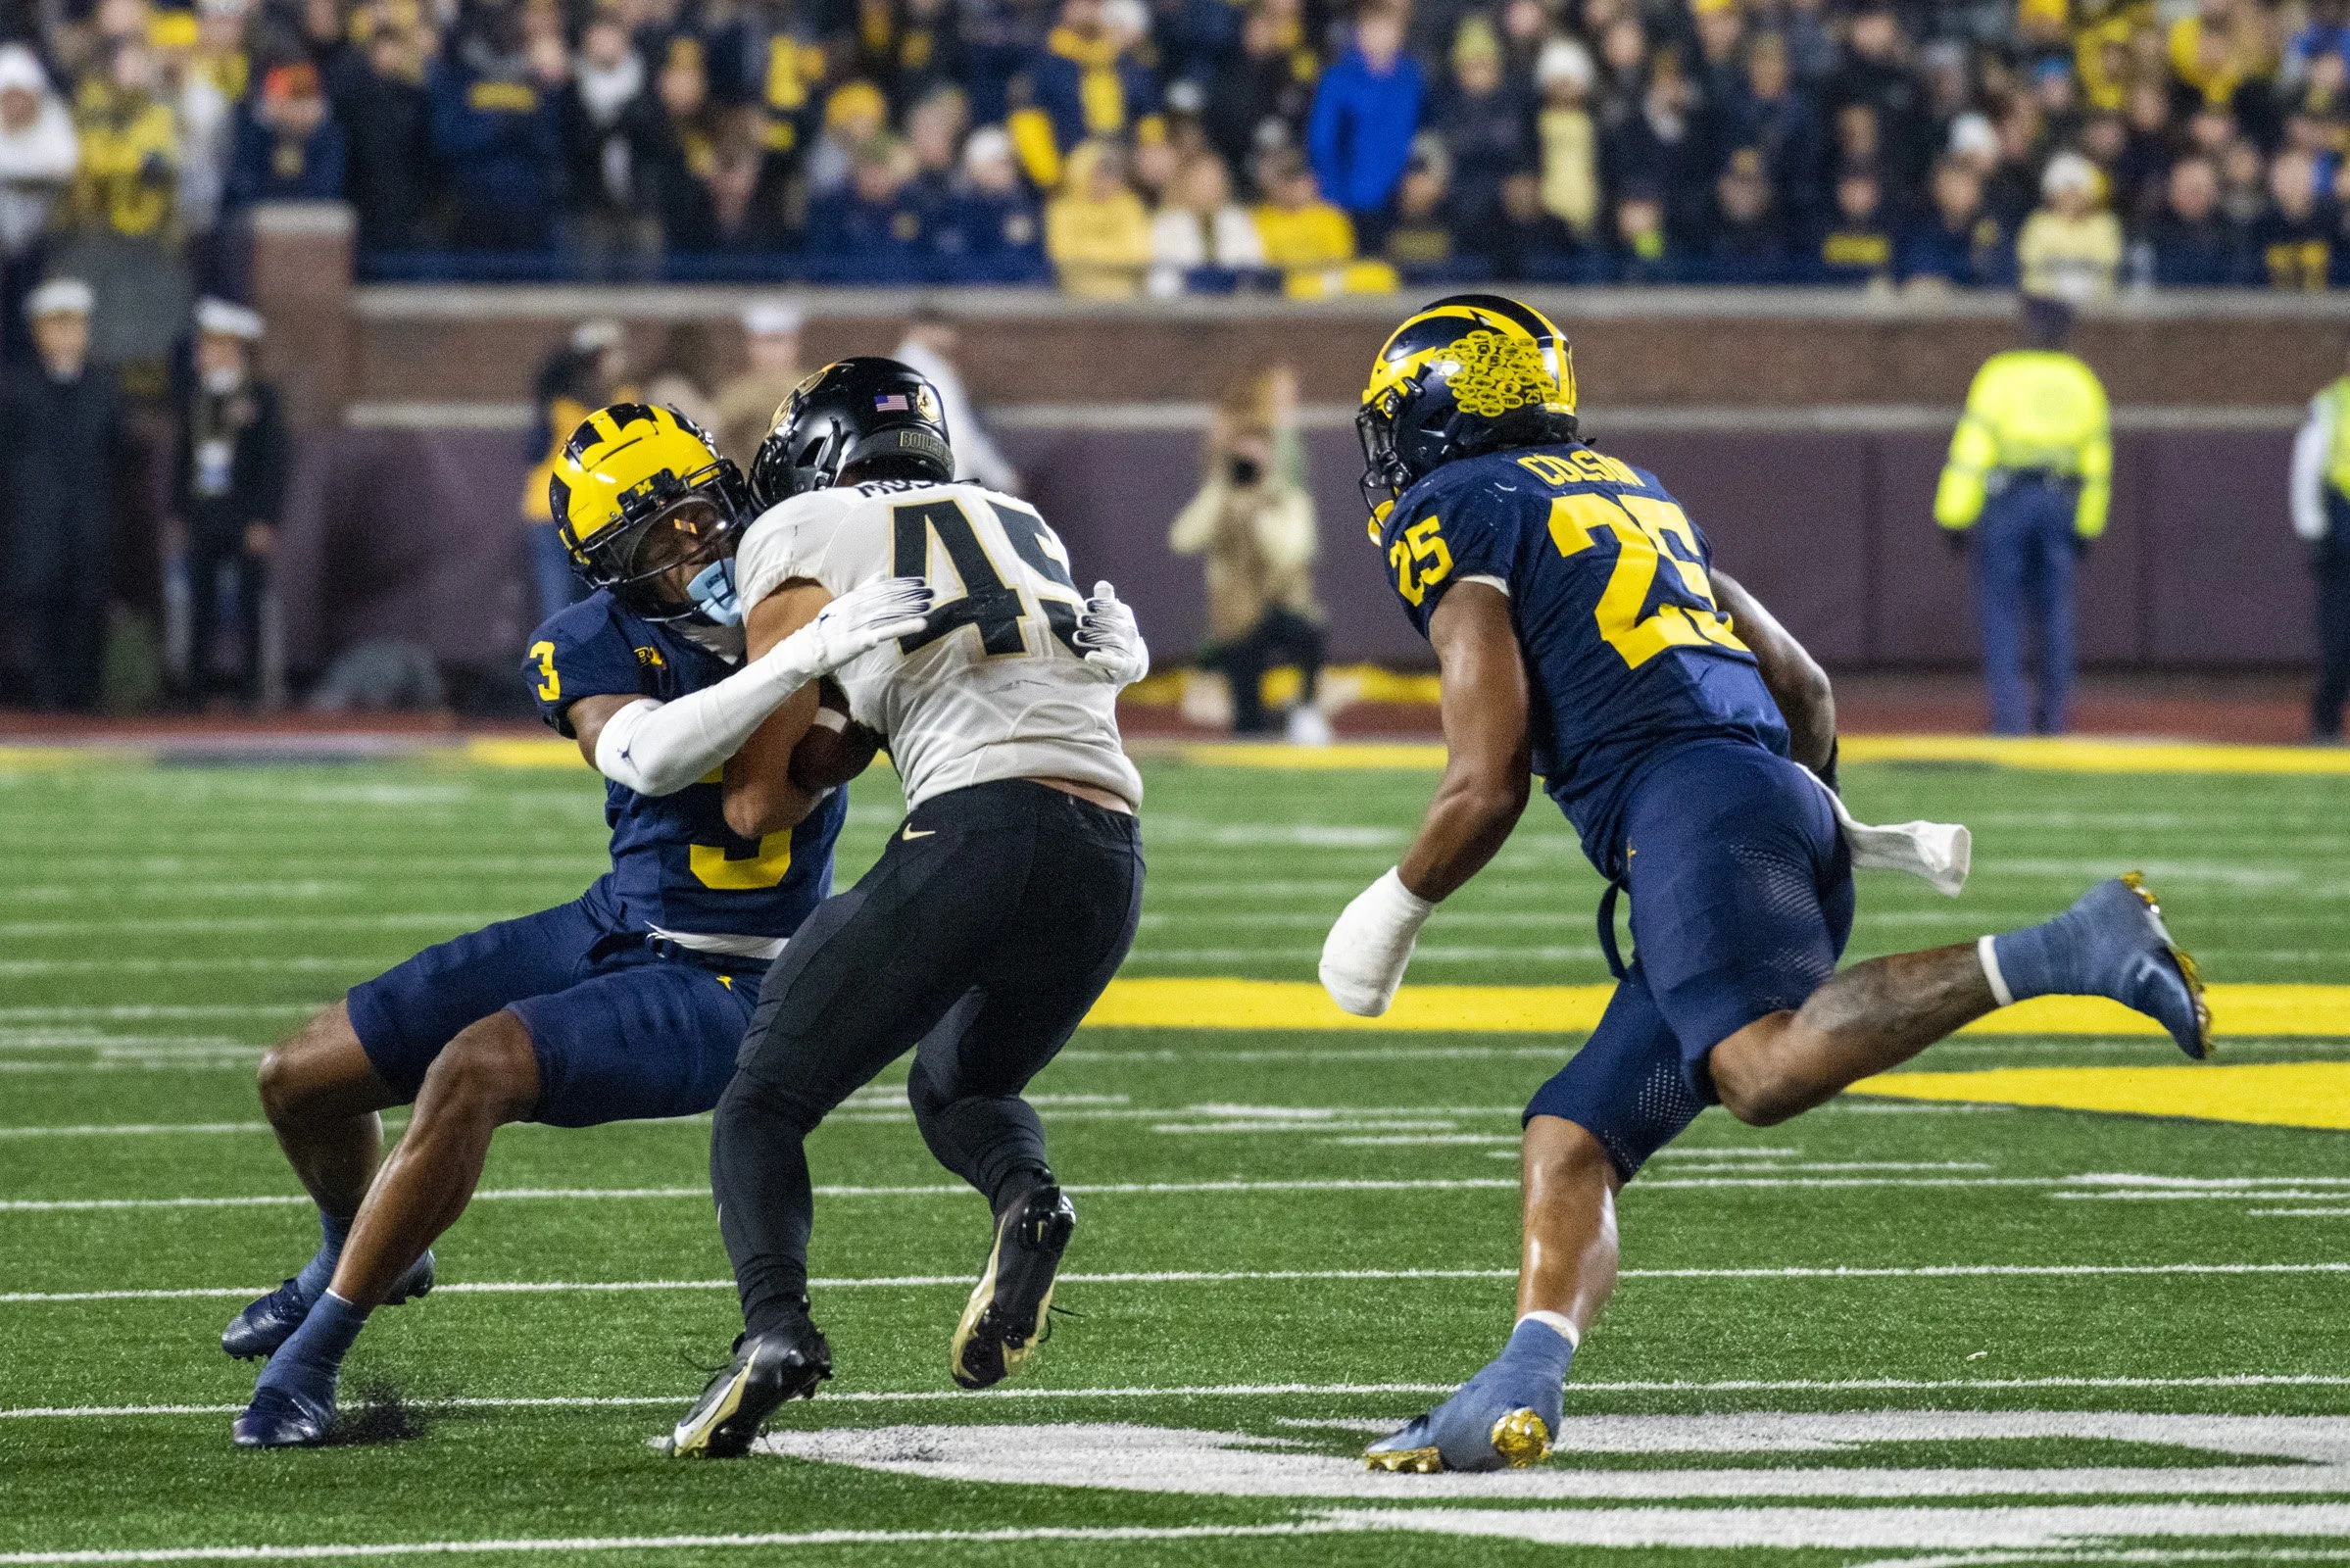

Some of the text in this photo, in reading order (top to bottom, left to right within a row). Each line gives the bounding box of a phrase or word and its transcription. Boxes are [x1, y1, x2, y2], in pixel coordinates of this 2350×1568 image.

[635, 478, 654, 496] M
[888, 497, 1099, 662] 45
[1389, 514, 1454, 607] 25
[1548, 493, 1750, 670] 25
[529, 640, 561, 701] 3
